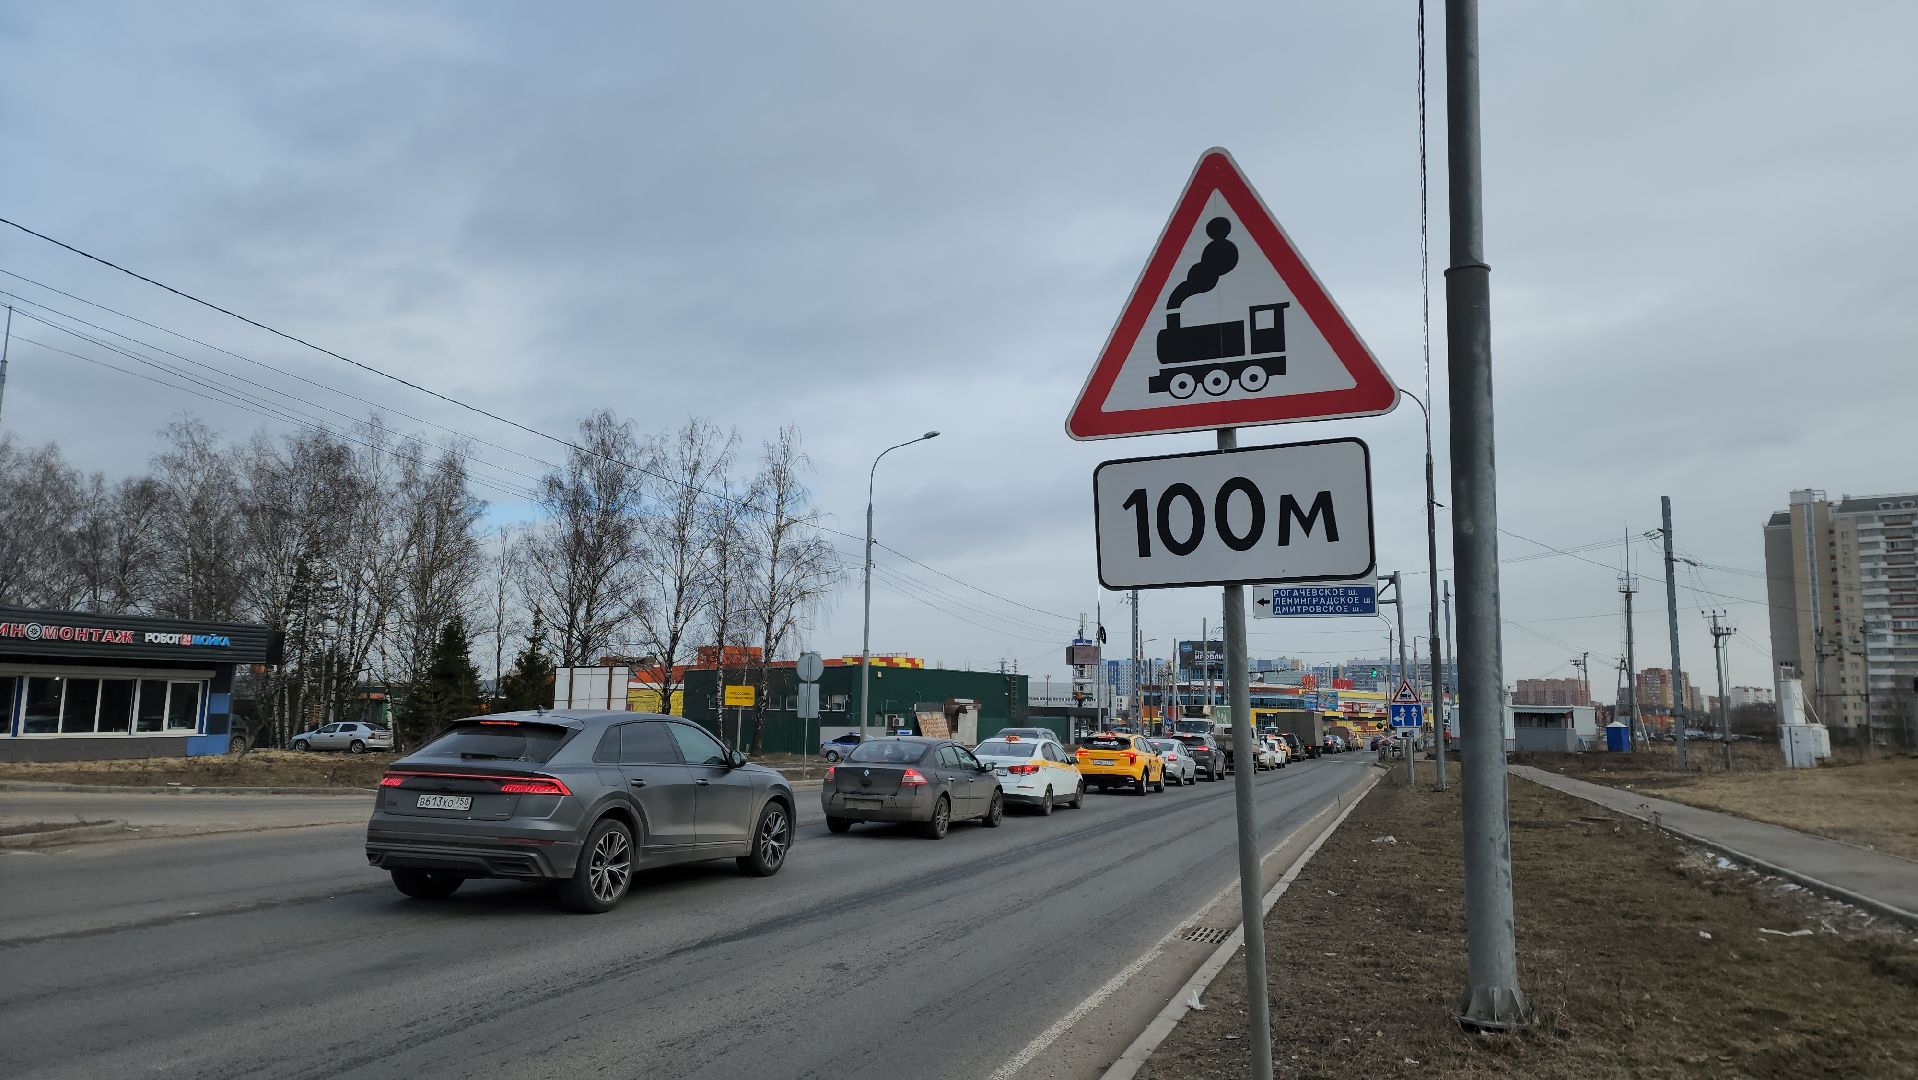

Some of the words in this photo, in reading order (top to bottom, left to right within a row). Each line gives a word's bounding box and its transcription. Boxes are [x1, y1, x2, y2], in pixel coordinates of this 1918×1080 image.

[1273, 588, 1344, 597] РОГАЧЕВСКОЕ
[1274, 597, 1360, 605] ЛЕНИНГРАДСКОЕ
[1274, 605, 1348, 614] ДМИТРОВСКОЕ
[144, 632, 181, 645] РОБОТ
